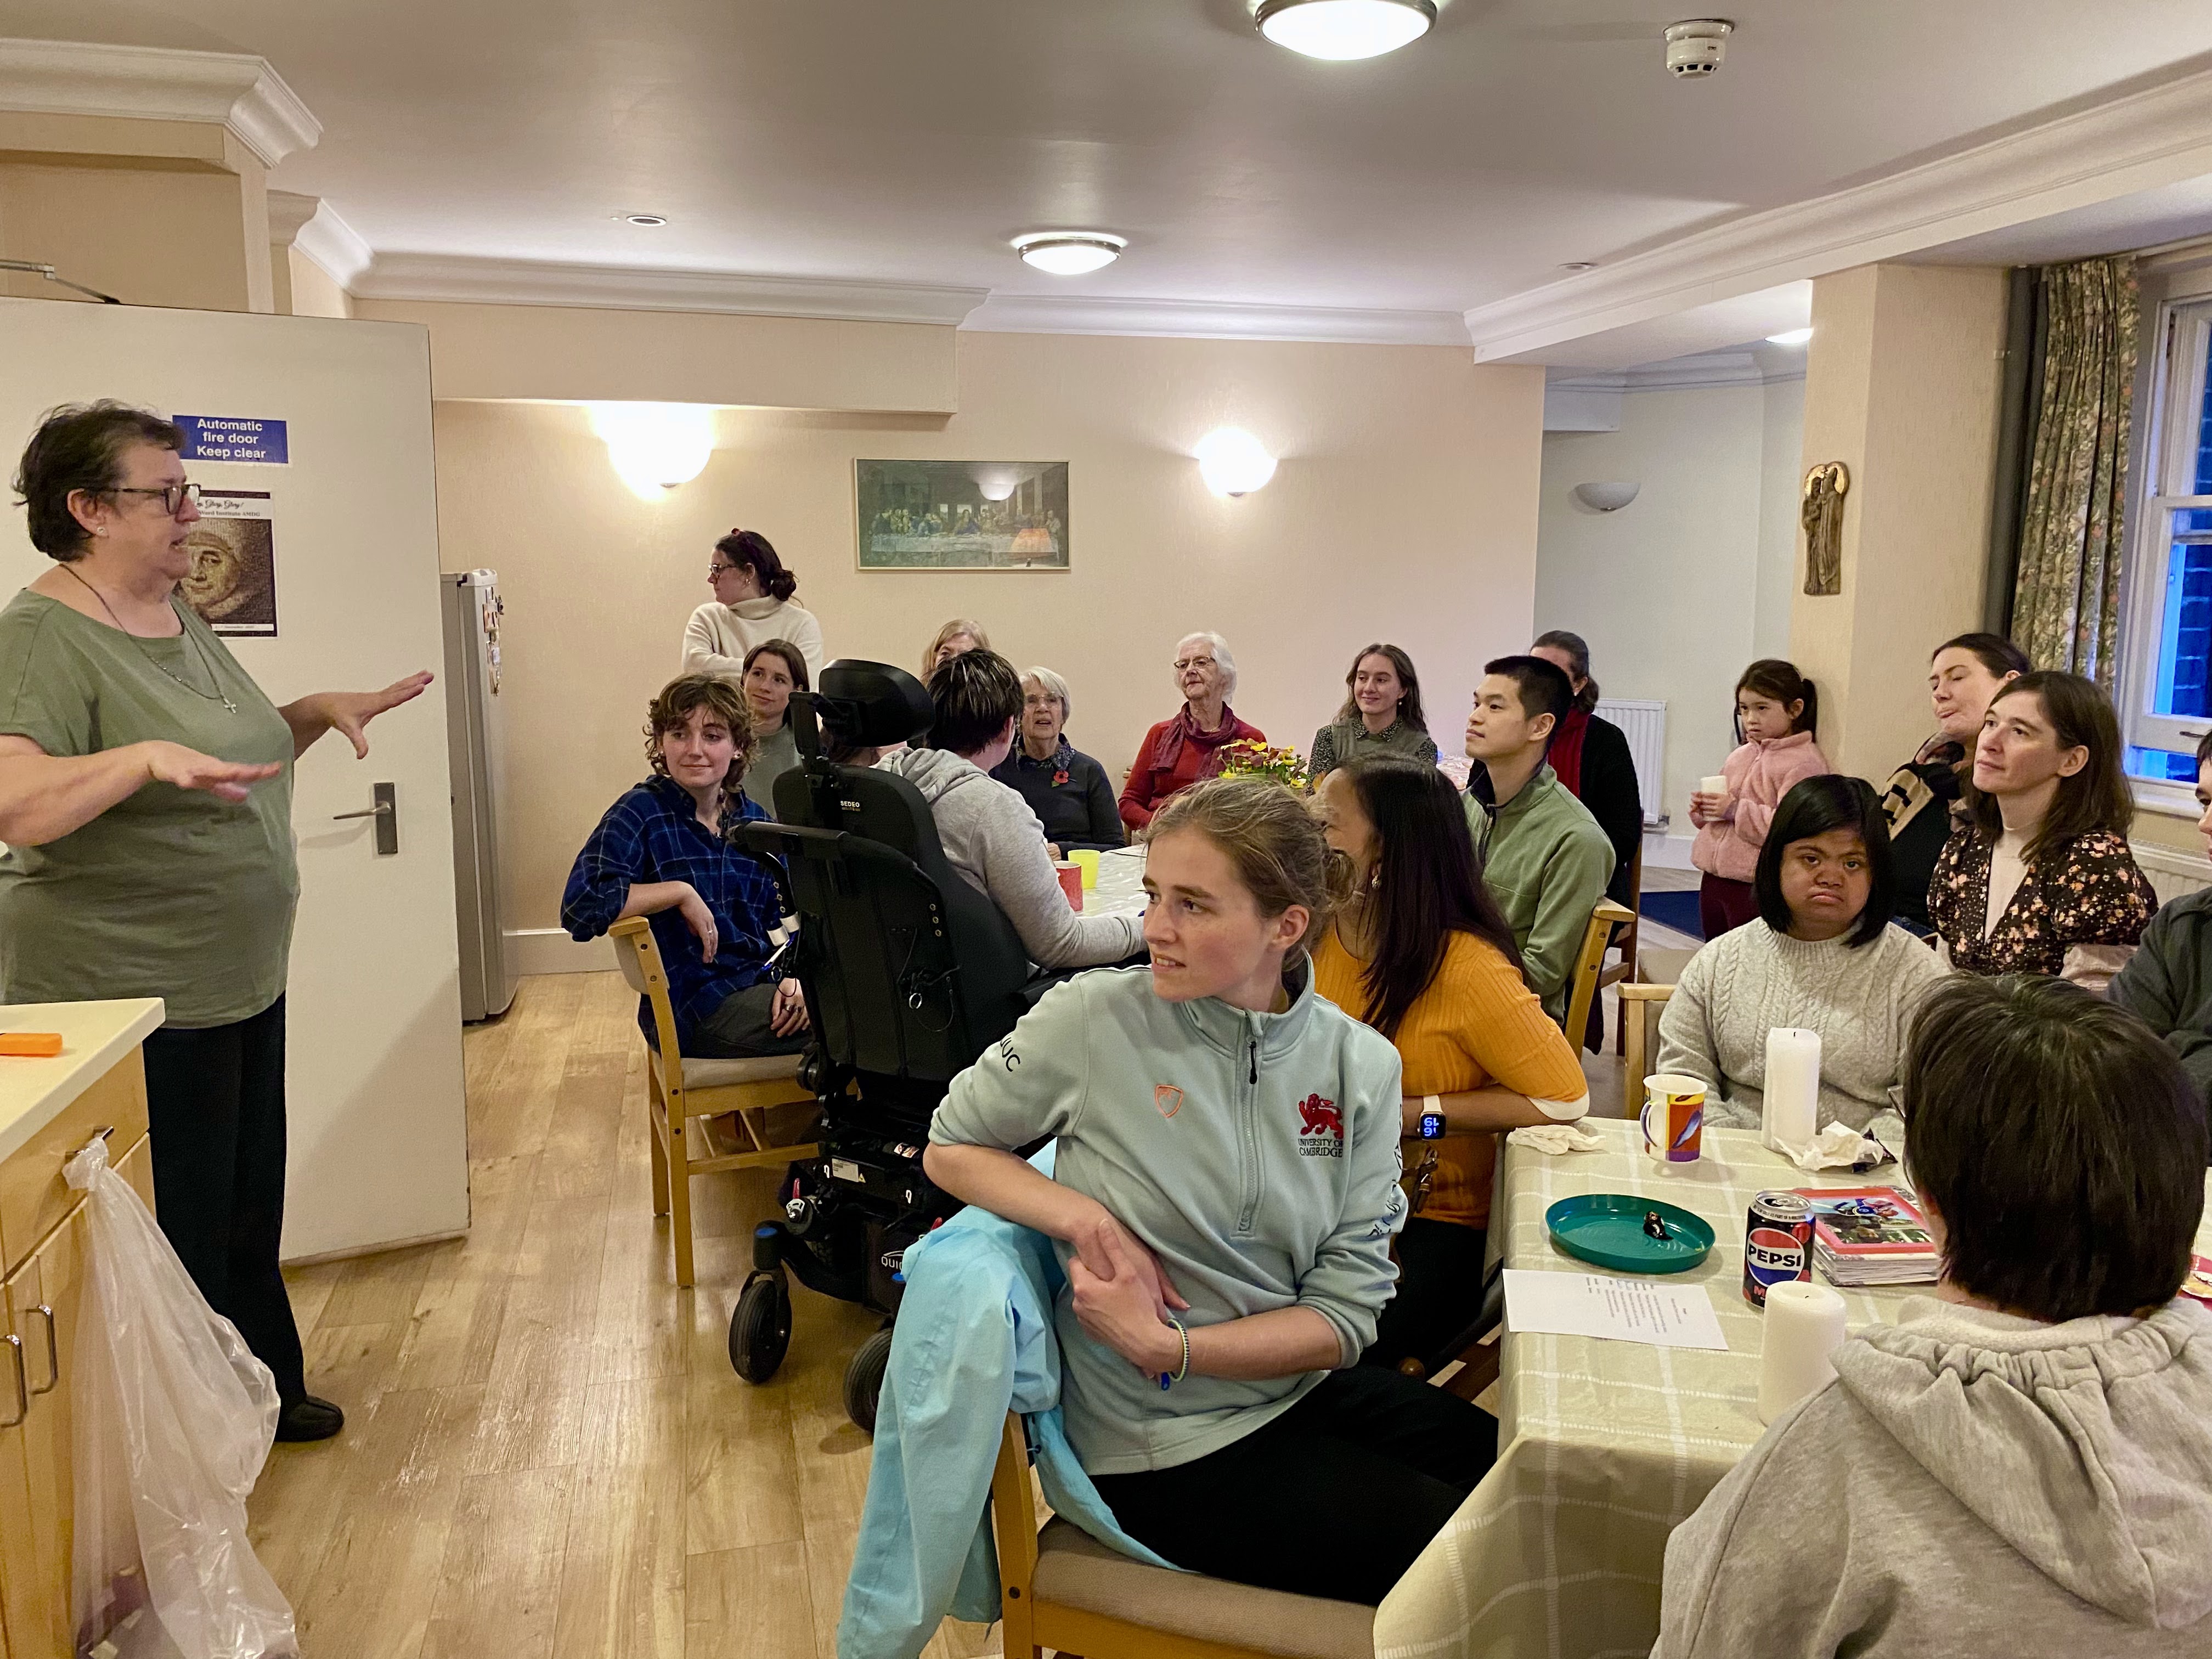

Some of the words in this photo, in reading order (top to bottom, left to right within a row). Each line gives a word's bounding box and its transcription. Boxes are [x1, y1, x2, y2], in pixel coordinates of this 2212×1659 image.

[197, 418, 263, 432] Automatic
[202, 431, 224, 443] fire
[228, 433, 259, 444] door
[197, 445, 230, 460] Keep
[234, 447, 266, 459] clear
[1298, 1138, 1333, 1147] UNIVERSITY
[1299, 1147, 1344, 1158] CAMBRIDGE
[1748, 1243, 1802, 1267] PEPSI
